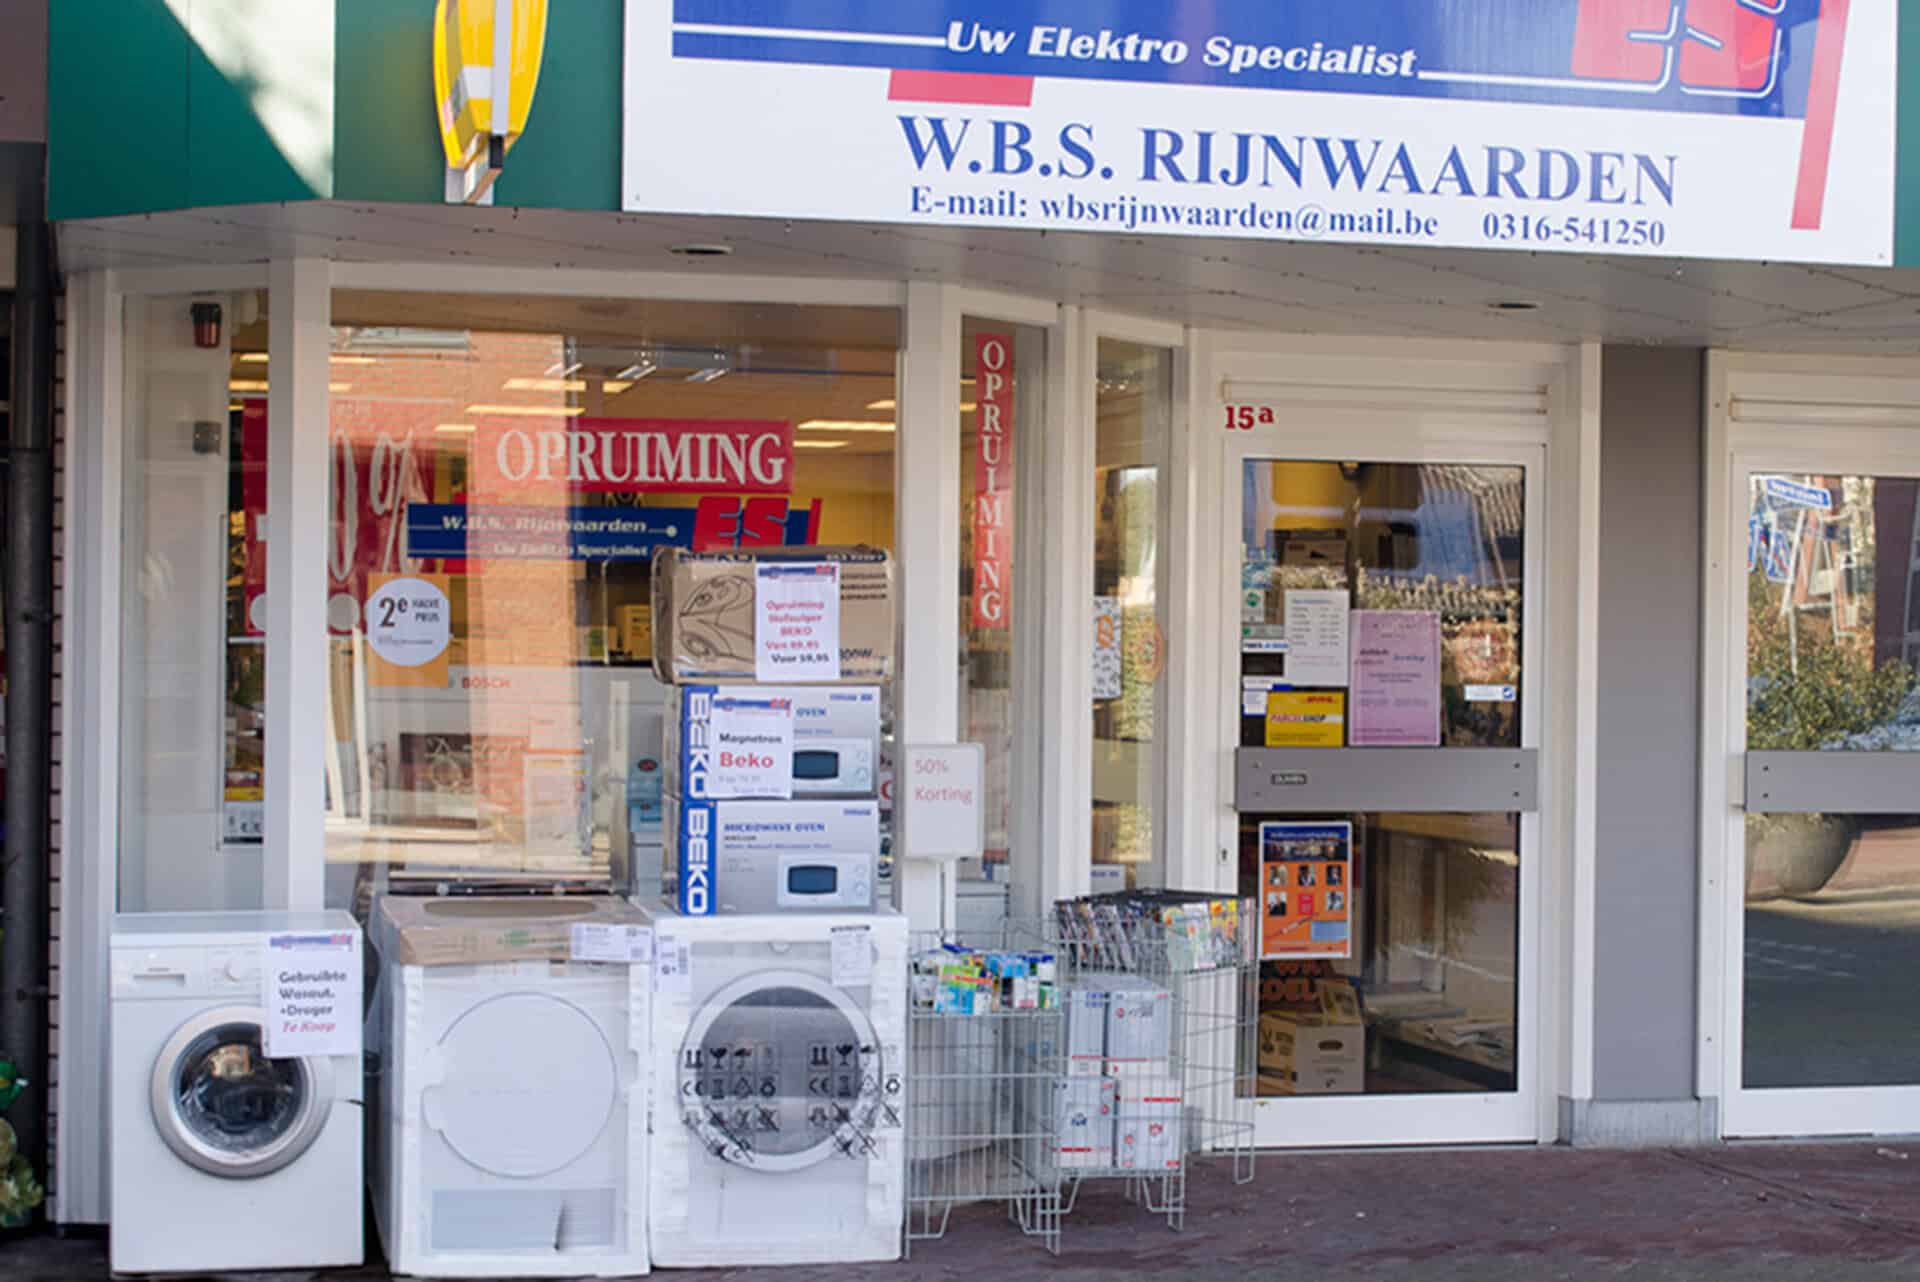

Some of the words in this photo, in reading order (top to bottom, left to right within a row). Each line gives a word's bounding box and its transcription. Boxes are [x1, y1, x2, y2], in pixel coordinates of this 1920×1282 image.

[948, 20, 1014, 54] Uw
[1028, 26, 1189, 65] Elektro
[1203, 36, 1417, 77] Specialist
[897, 114, 1113, 180] W.B.S.
[1138, 127, 1679, 208] RIJNWAARDEN
[910, 185, 1027, 218] E-mail:
[1040, 190, 1439, 238] wbsrijnwaarden@mail.be
[1482, 212, 1665, 246] 0316-541250
[1225, 406, 1275, 430] 15a
[496, 428, 787, 486] OPRUIMING
[977, 340, 1006, 622] OPRUIMING
[577, 545, 648, 557] Specialist
[378, 596, 408, 628] 2e
[771, 653, 797, 663] Voor
[689, 693, 711, 798] BEKO
[719, 733, 783, 745] Magnetron
[719, 750, 775, 769] Beko
[914, 757, 949, 775] 50%
[914, 787, 973, 805] Korting
[688, 808, 710, 915] BEKO
